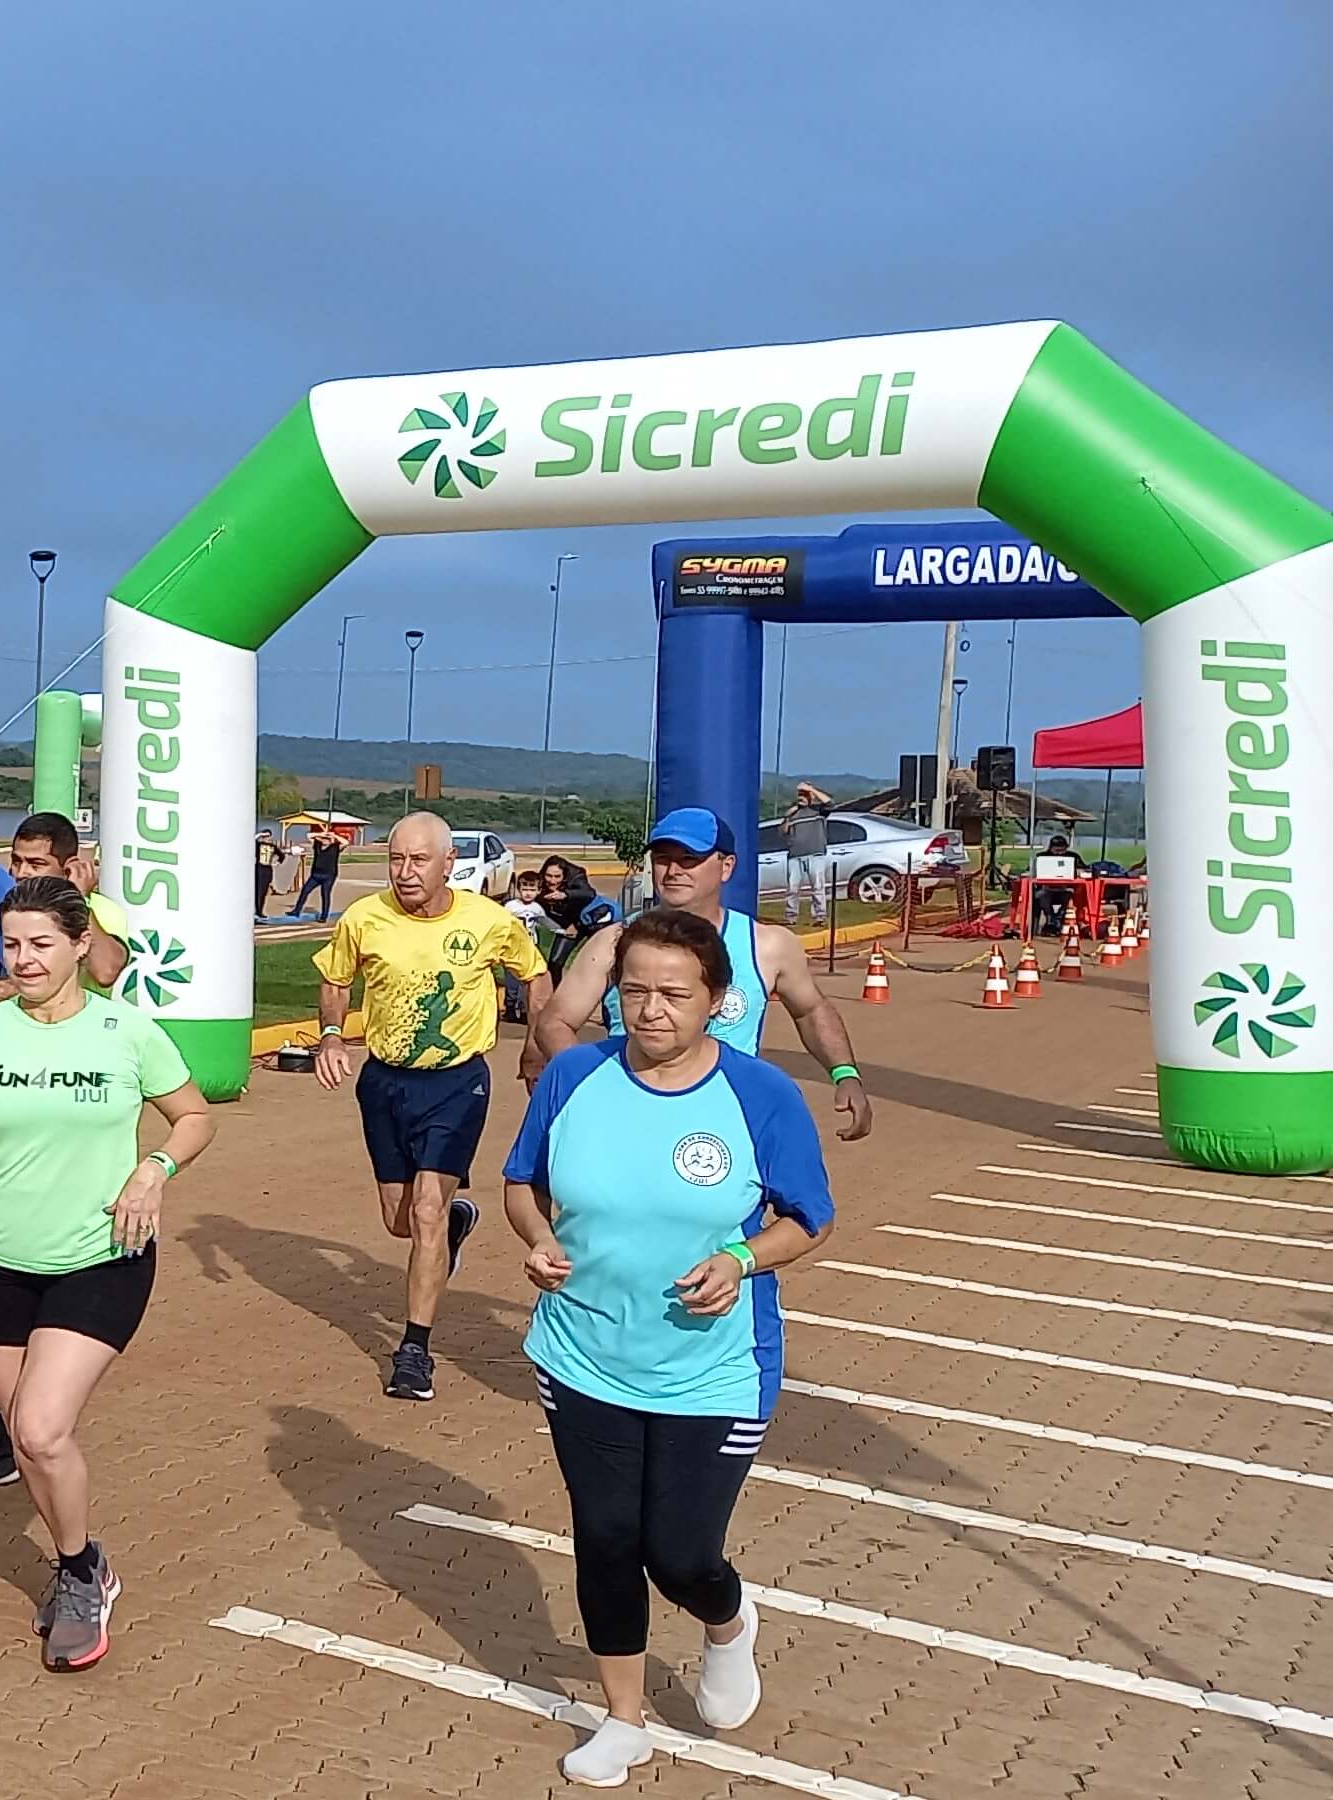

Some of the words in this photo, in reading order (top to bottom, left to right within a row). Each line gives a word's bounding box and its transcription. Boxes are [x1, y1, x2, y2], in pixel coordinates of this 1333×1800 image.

[533, 371, 916, 478] Sicredi
[680, 557, 788, 575] SYGMA
[122, 666, 181, 911] Sicredi
[1200, 639, 1295, 939] Sicredi
